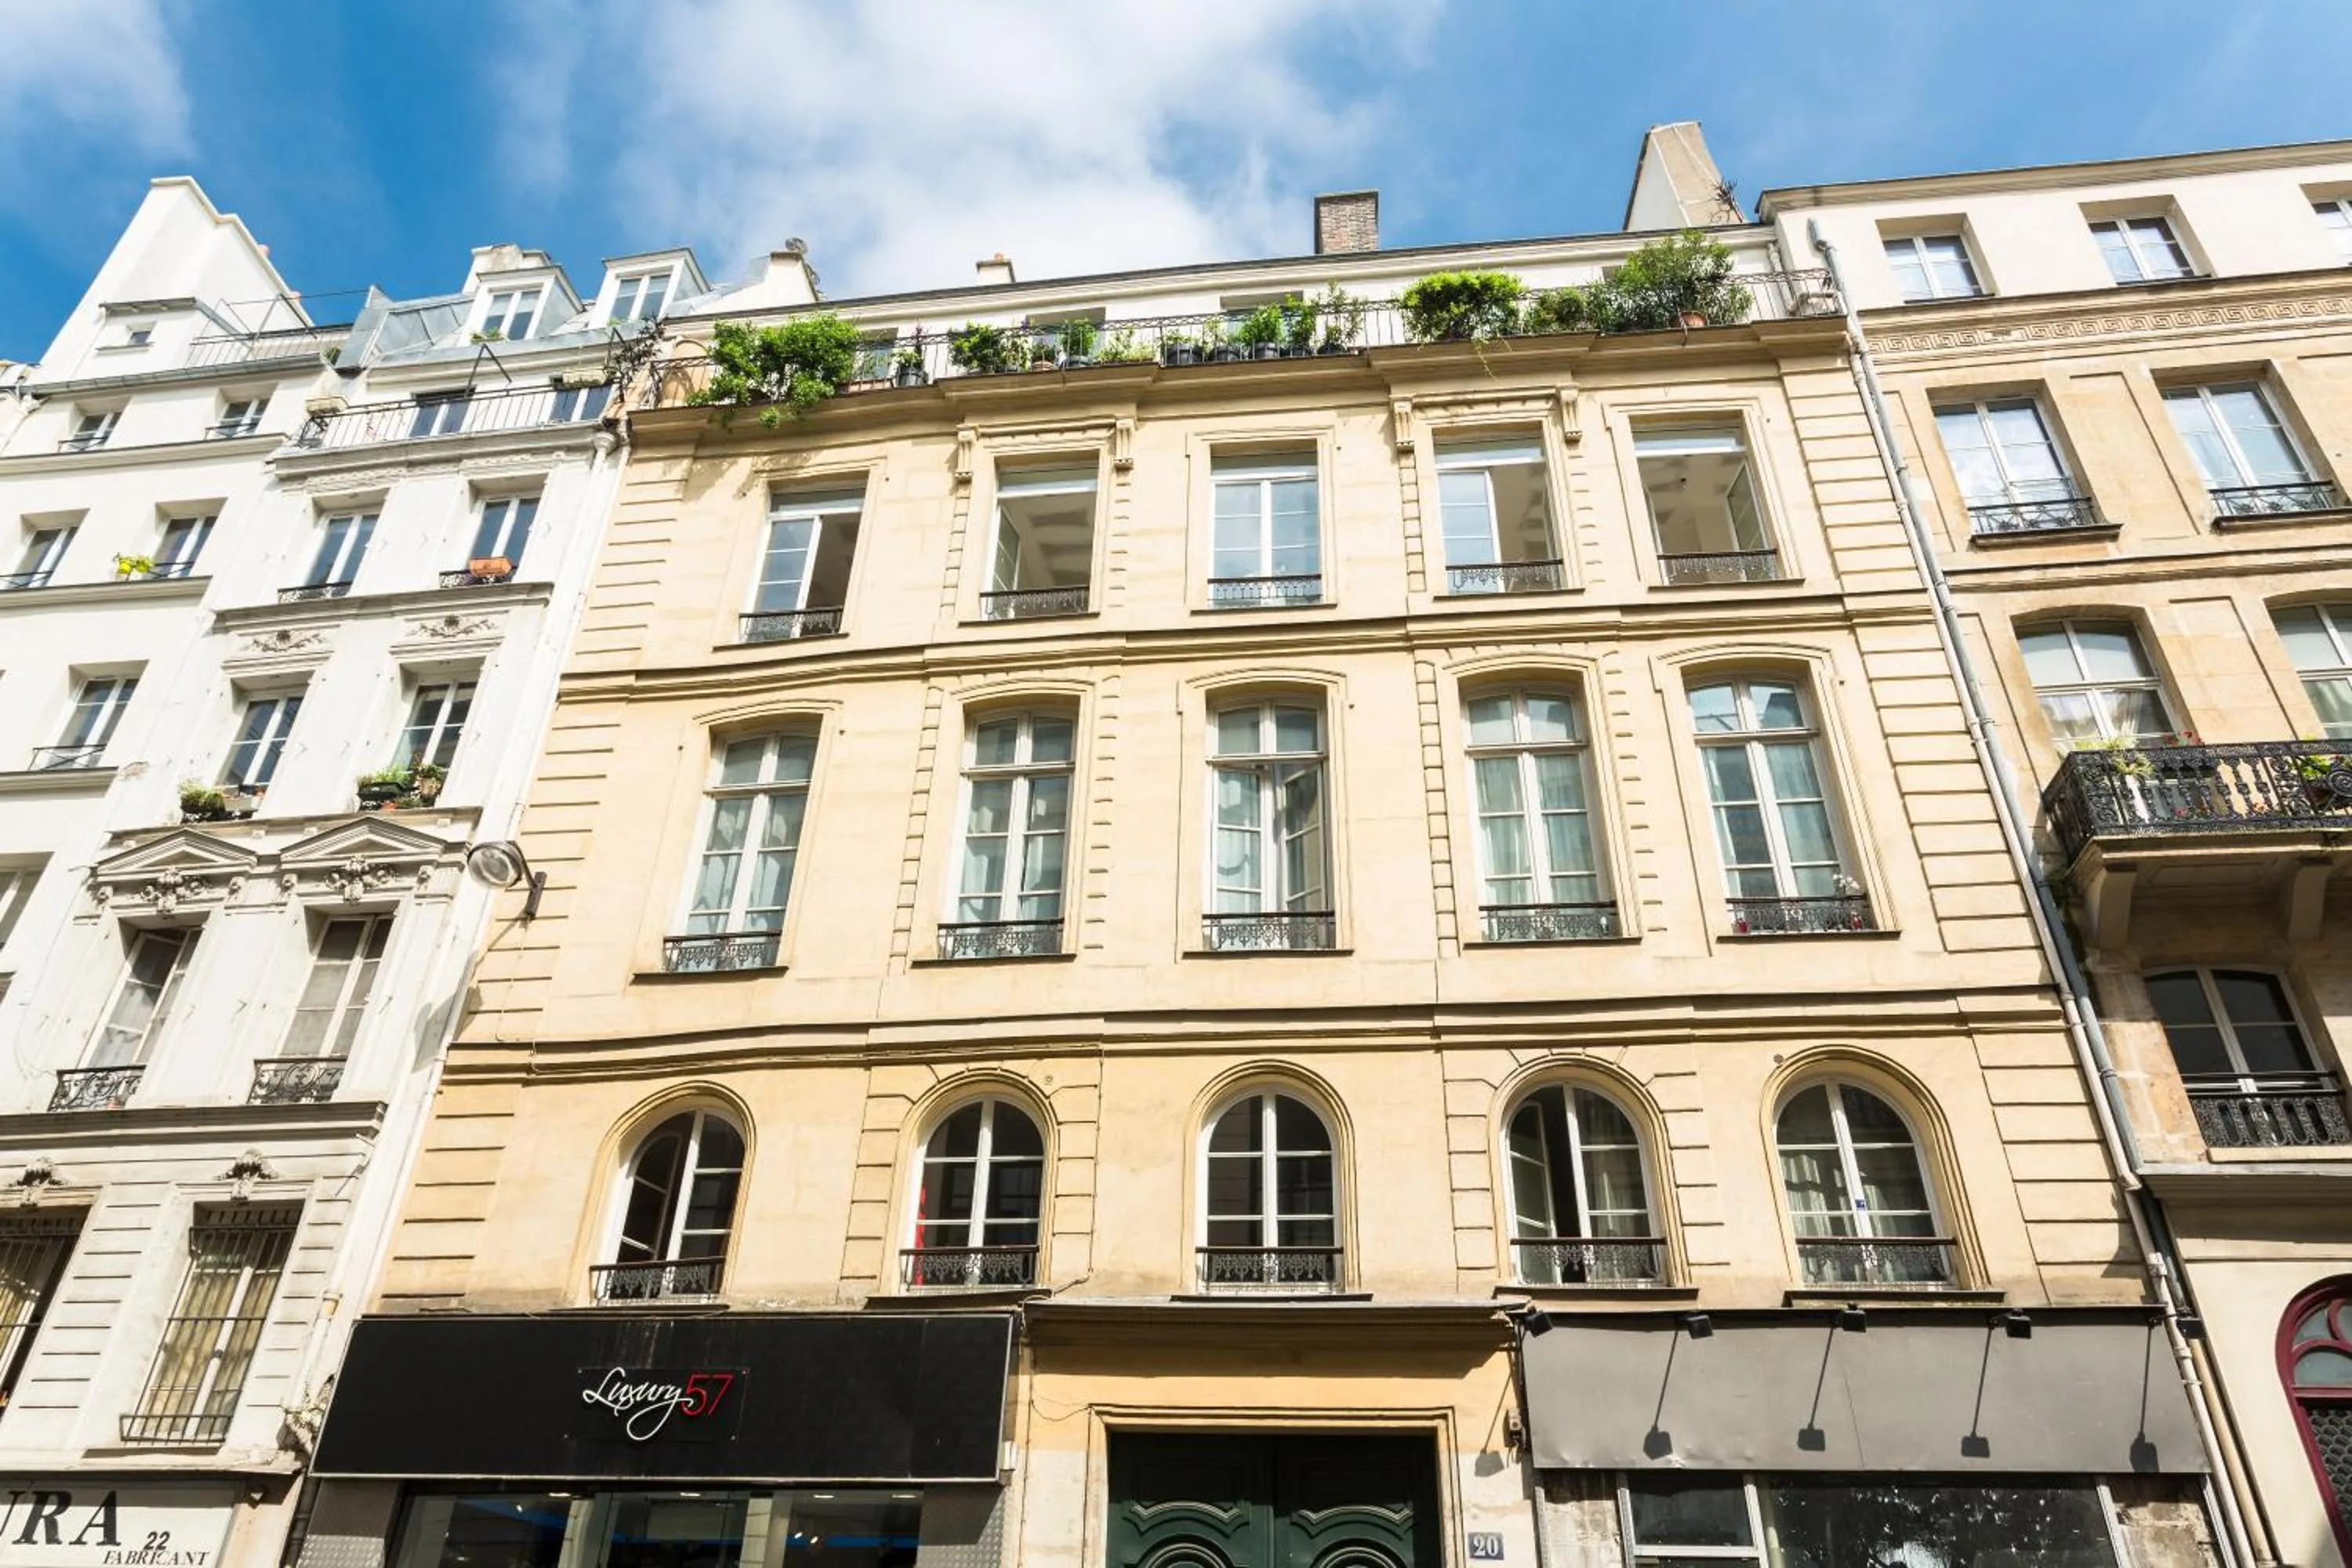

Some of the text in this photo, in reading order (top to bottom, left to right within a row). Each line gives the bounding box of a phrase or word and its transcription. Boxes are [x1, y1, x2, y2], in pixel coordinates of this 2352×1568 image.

[143, 1530, 170, 1551] 22
[1473, 1535, 1499, 1556] 20
[102, 1550, 211, 1566] FABRICANT
